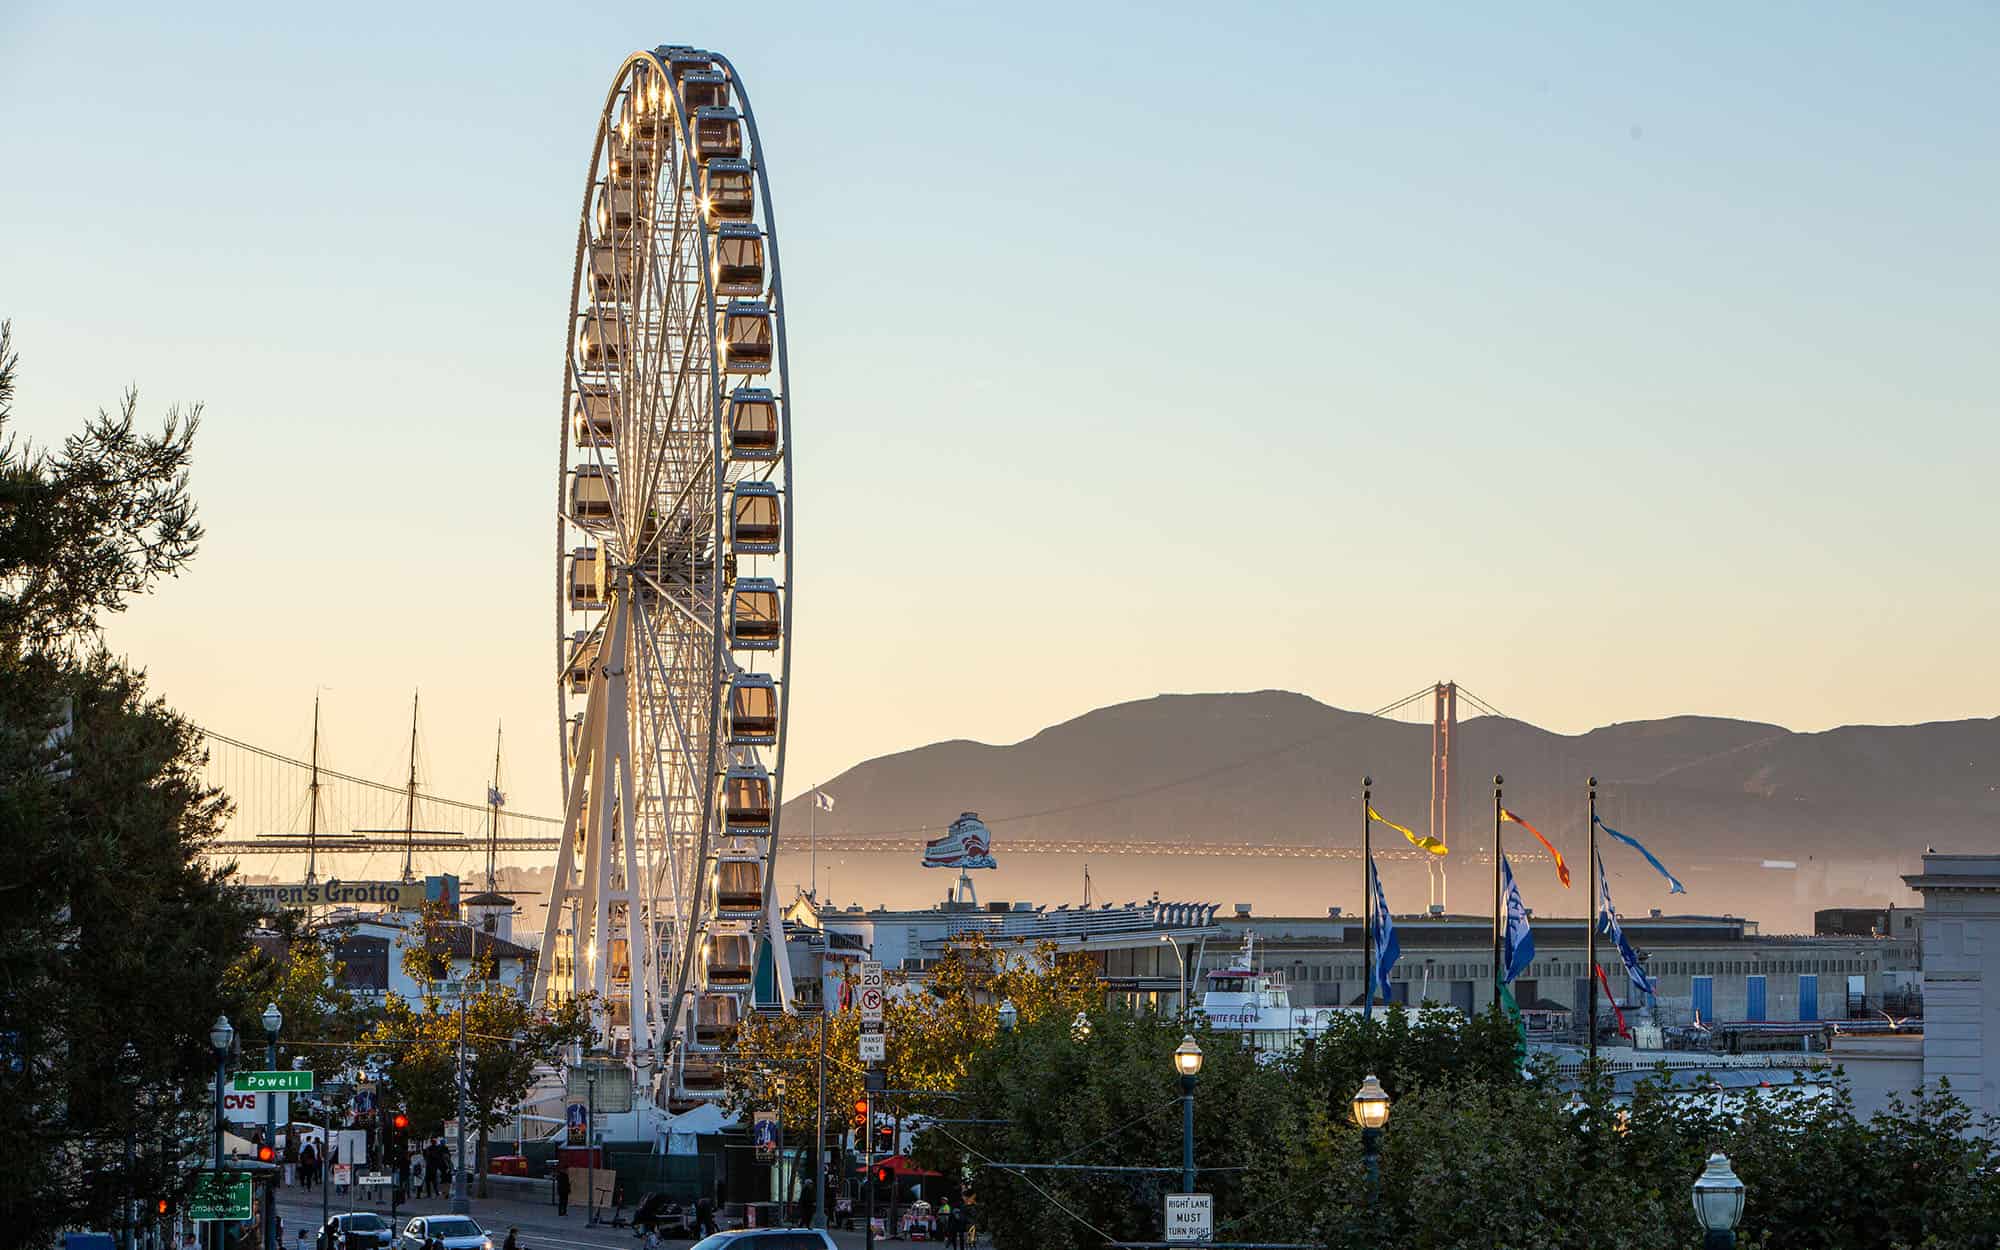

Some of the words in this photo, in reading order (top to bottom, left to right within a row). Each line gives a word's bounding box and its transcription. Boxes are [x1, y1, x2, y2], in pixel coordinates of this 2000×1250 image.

[324, 879, 400, 903] Grotto
[864, 975, 880, 985] 20
[1229, 1014, 1254, 1023] FLEET
[862, 1036, 883, 1044] TRANSIT
[247, 1076, 299, 1087] Powell
[223, 1094, 256, 1110] CVS
[1168, 1200, 1189, 1208] RIGHT
[1190, 1200, 1209, 1208] LANE
[1176, 1212, 1201, 1222] MUST
[1168, 1227, 1187, 1235] TURN
